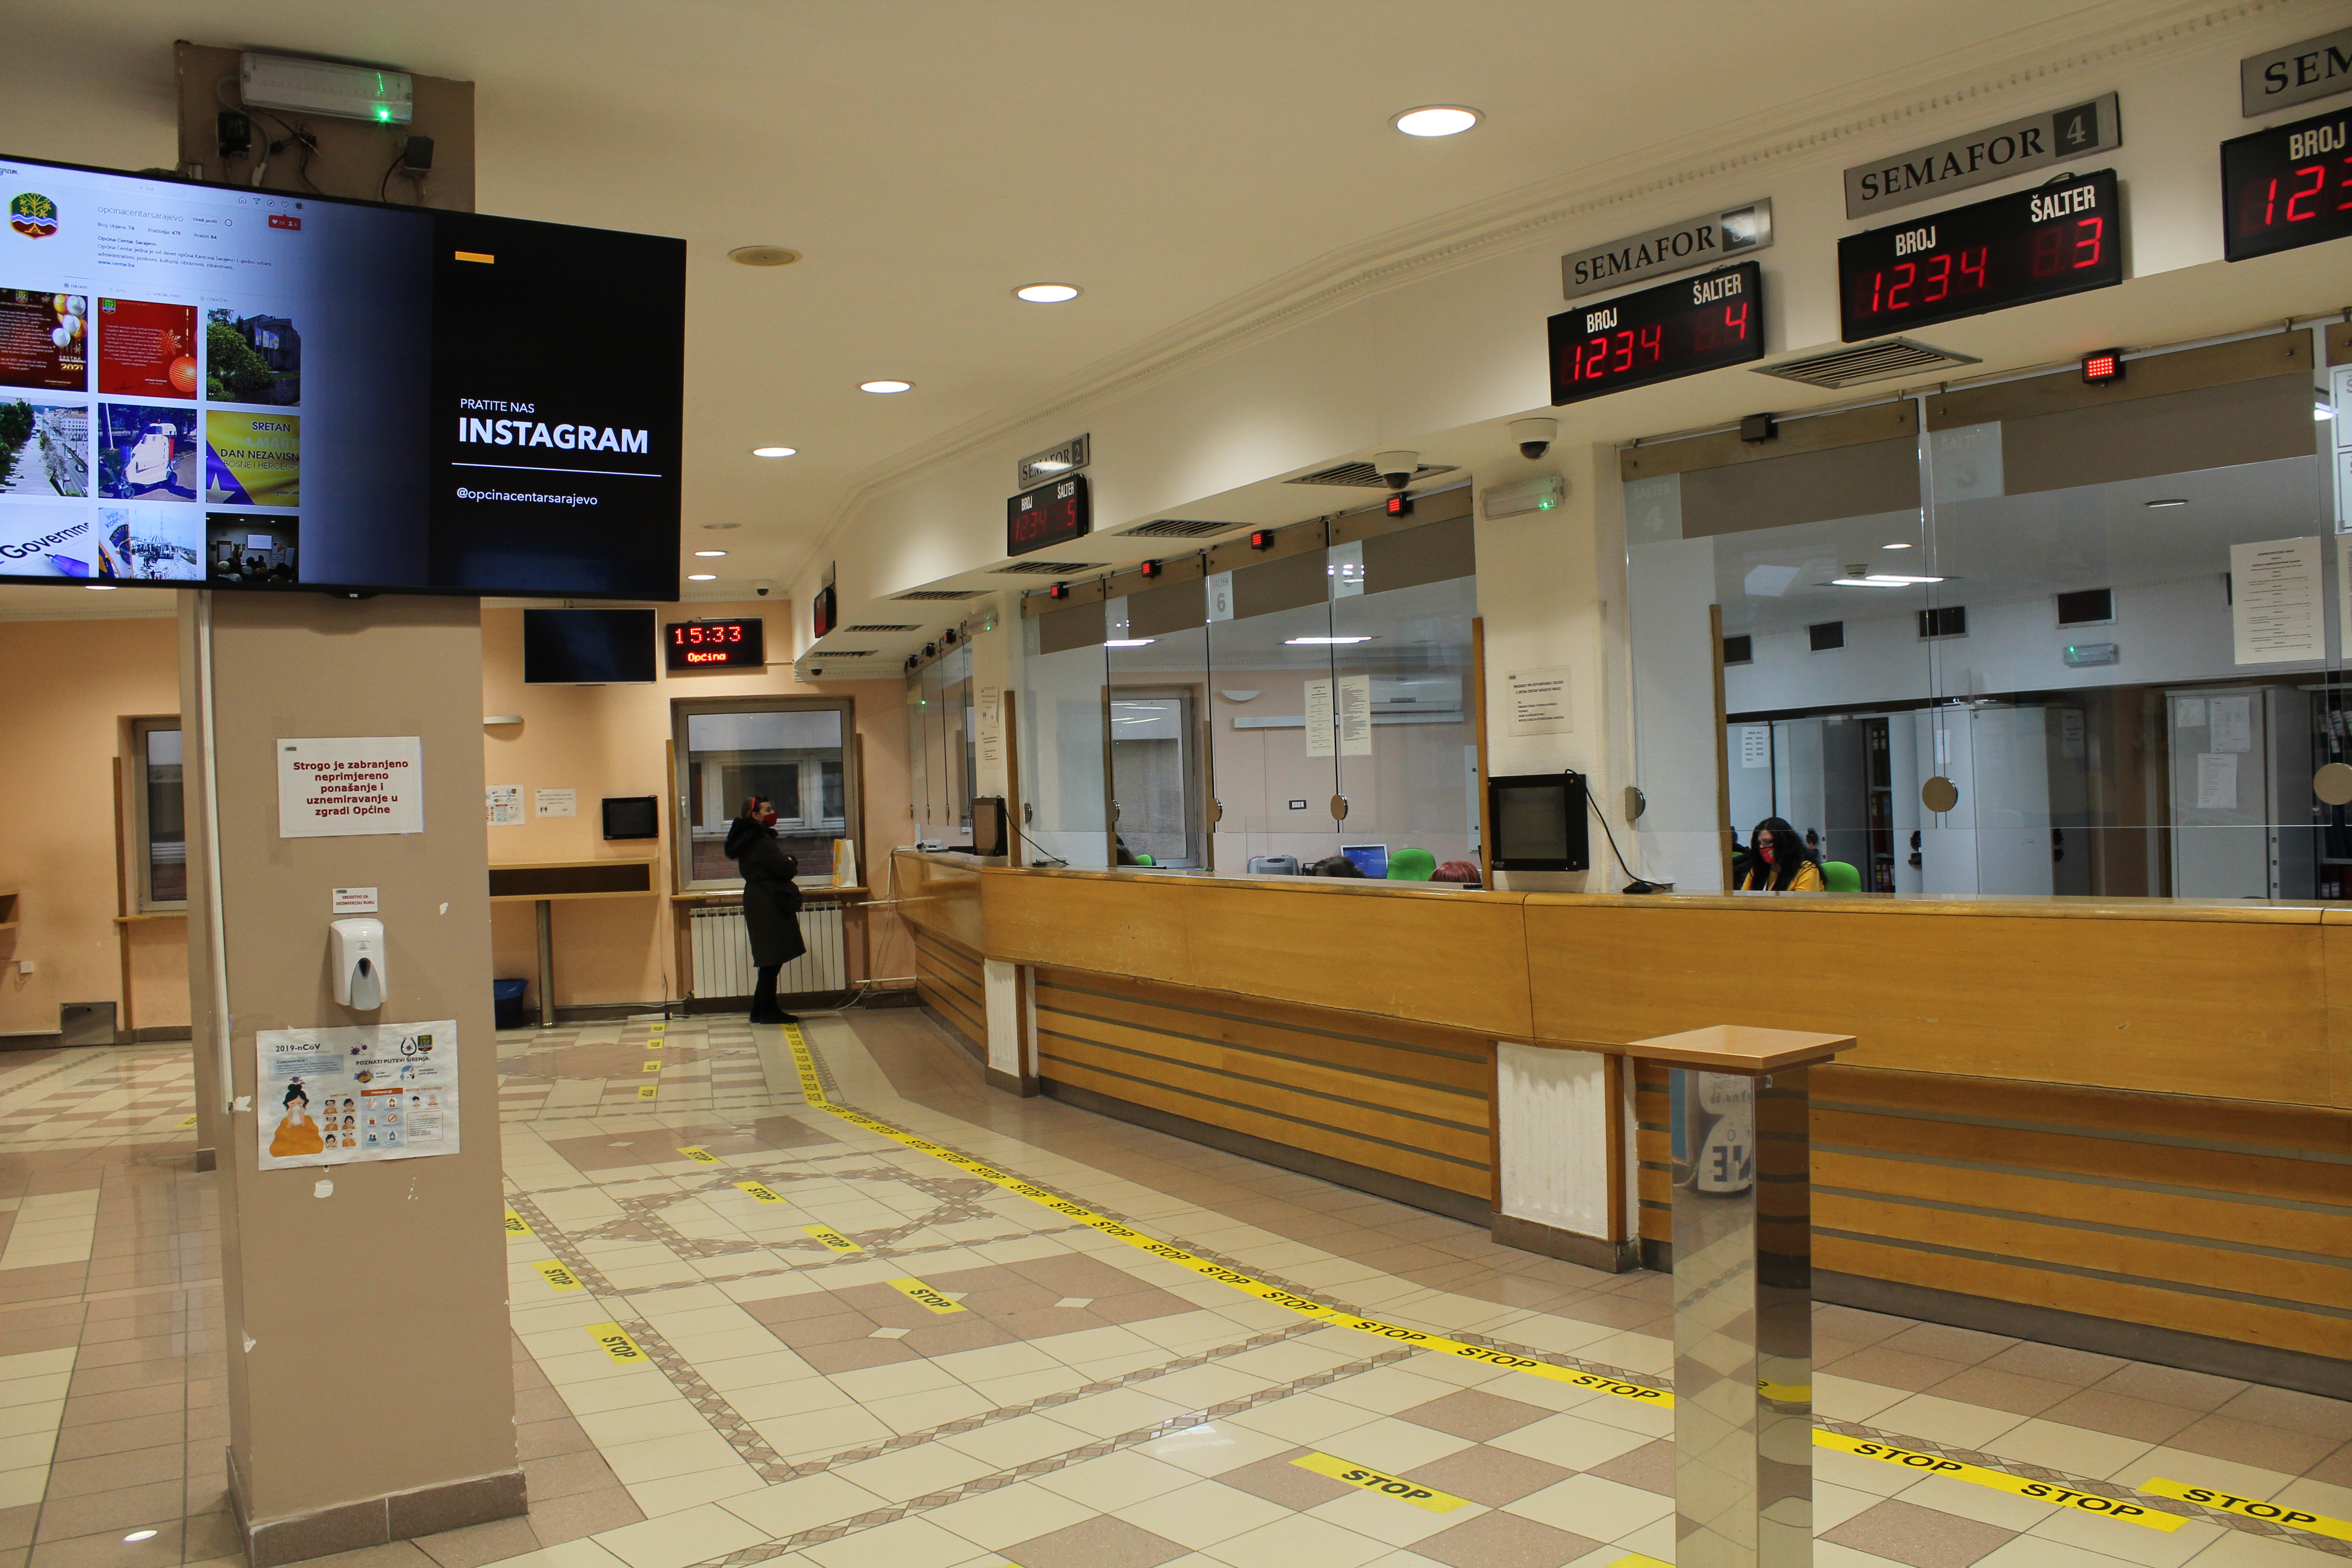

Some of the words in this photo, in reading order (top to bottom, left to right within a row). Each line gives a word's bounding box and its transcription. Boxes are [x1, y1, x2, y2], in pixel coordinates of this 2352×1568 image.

[2290, 122, 2345, 161] BROJ
[1861, 127, 2045, 201] SEMAFOR
[2067, 115, 2086, 144] 4
[2031, 185, 2095, 222] ŠALTER
[98, 206, 183, 222] opcinacentarsarajevo
[1896, 226, 1936, 256] BROJ
[2073, 217, 2102, 268] 3
[1575, 226, 1716, 285] SEMAFOR
[1873, 247, 1986, 312] 1234
[1693, 274, 1742, 305] ŠALTER
[1587, 308, 1617, 333] BROJ
[1725, 302, 1747, 339] 4
[1574, 325, 1661, 380] 1234
[461, 398, 507, 412] PRATITE
[510, 402, 535, 413] NAS
[252, 421, 290, 432] SRETAN
[459, 417, 648, 454] INSTAGRAM
[220, 449, 244, 458] DAN
[1075, 445, 1080, 461] 2
[224, 460, 251, 468] BOSNE
[457, 487, 598, 507] @opcinacentarsarajevo
[1058, 482, 1074, 499] ŠALTER
[1021, 496, 1033, 511] BROJ
[1067, 499, 1075, 526] 5
[1016, 510, 1047, 540] 1234
[1217, 593, 1226, 612] 6
[675, 626, 742, 644] 15:33
[688, 652, 726, 662] Općina
[294, 762, 330, 771] Strogo
[333, 761, 344, 770] je
[348, 760, 408, 769] zabranjeno
[315, 772, 389, 782] neprimjereno
[321, 783, 377, 794] ponašanje
[307, 794, 388, 804] uznemiravanje
[315, 807, 349, 817] zgradi
[353, 806, 390, 815] Općine
[276, 1044, 321, 1052] 2019-nCoV
[843, 1115, 867, 1123] STOP
[870, 1126, 899, 1134] STOP
[906, 1140, 936, 1149] STOP
[689, 1152, 712, 1161] STOP
[938, 1150, 970, 1163] STOP
[971, 1166, 1006, 1179] STOP
[748, 1188, 776, 1200] STOP
[1009, 1184, 1047, 1197] STOP
[1049, 1202, 1088, 1215] STOP
[1092, 1221, 1135, 1236] STOP
[817, 1234, 850, 1247] STOP
[1142, 1243, 1191, 1259] STOP
[544, 1269, 573, 1284] STOP
[1198, 1266, 1251, 1284] STOP
[909, 1289, 952, 1307] STOP
[1261, 1291, 1319, 1310] STOP
[1352, 1321, 1427, 1340] STOP
[601, 1336, 638, 1357] STOP
[1455, 1347, 1538, 1367] STOP
[1572, 1375, 1661, 1398] STOP
[1853, 1443, 1963, 1471] STOP
[1341, 1470, 1433, 1499] STOP
[2020, 1483, 2148, 1516] STOP
[2182, 1488, 2317, 1526] STOP
